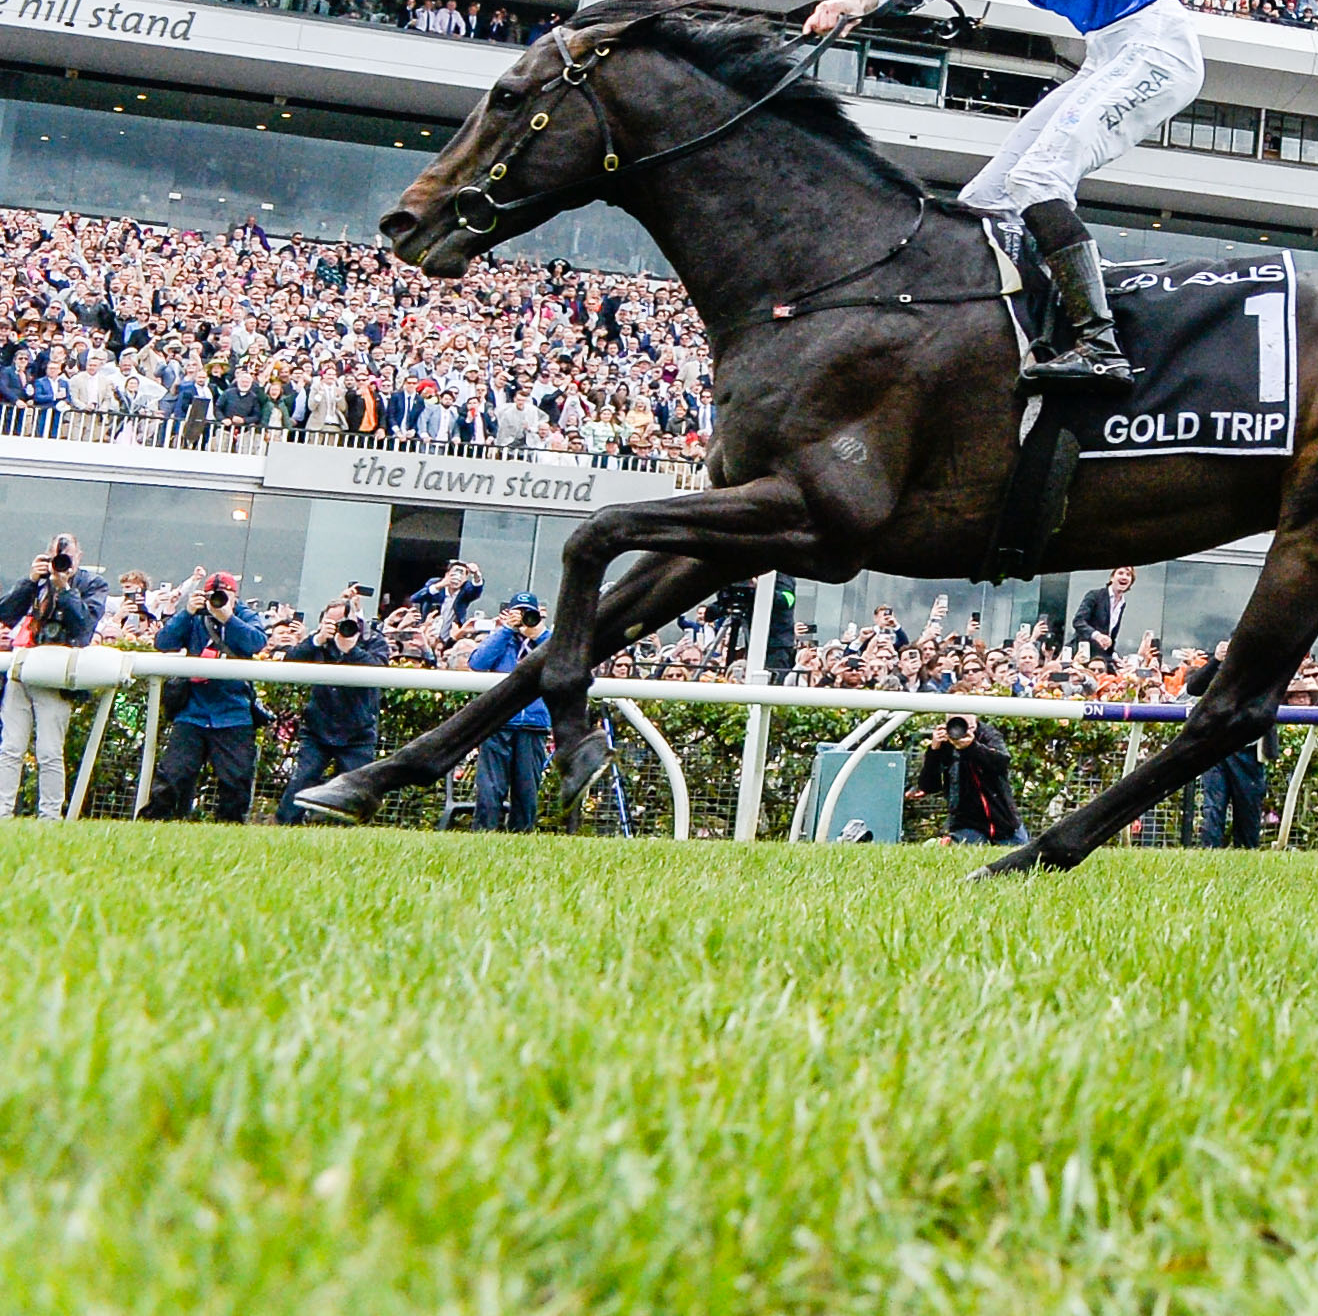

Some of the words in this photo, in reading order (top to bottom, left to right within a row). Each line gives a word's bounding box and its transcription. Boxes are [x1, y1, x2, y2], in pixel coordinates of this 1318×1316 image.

[88, 2, 196, 41] stand
[1099, 68, 1169, 131] ZAHRA
[1163, 264, 1286, 292] LEXUS
[1244, 292, 1287, 403] 1
[1104, 412, 1200, 444] GOLD
[1210, 411, 1286, 442] TRIP
[353, 456, 405, 487] the
[414, 461, 496, 496] lawn
[503, 471, 596, 502] stand
